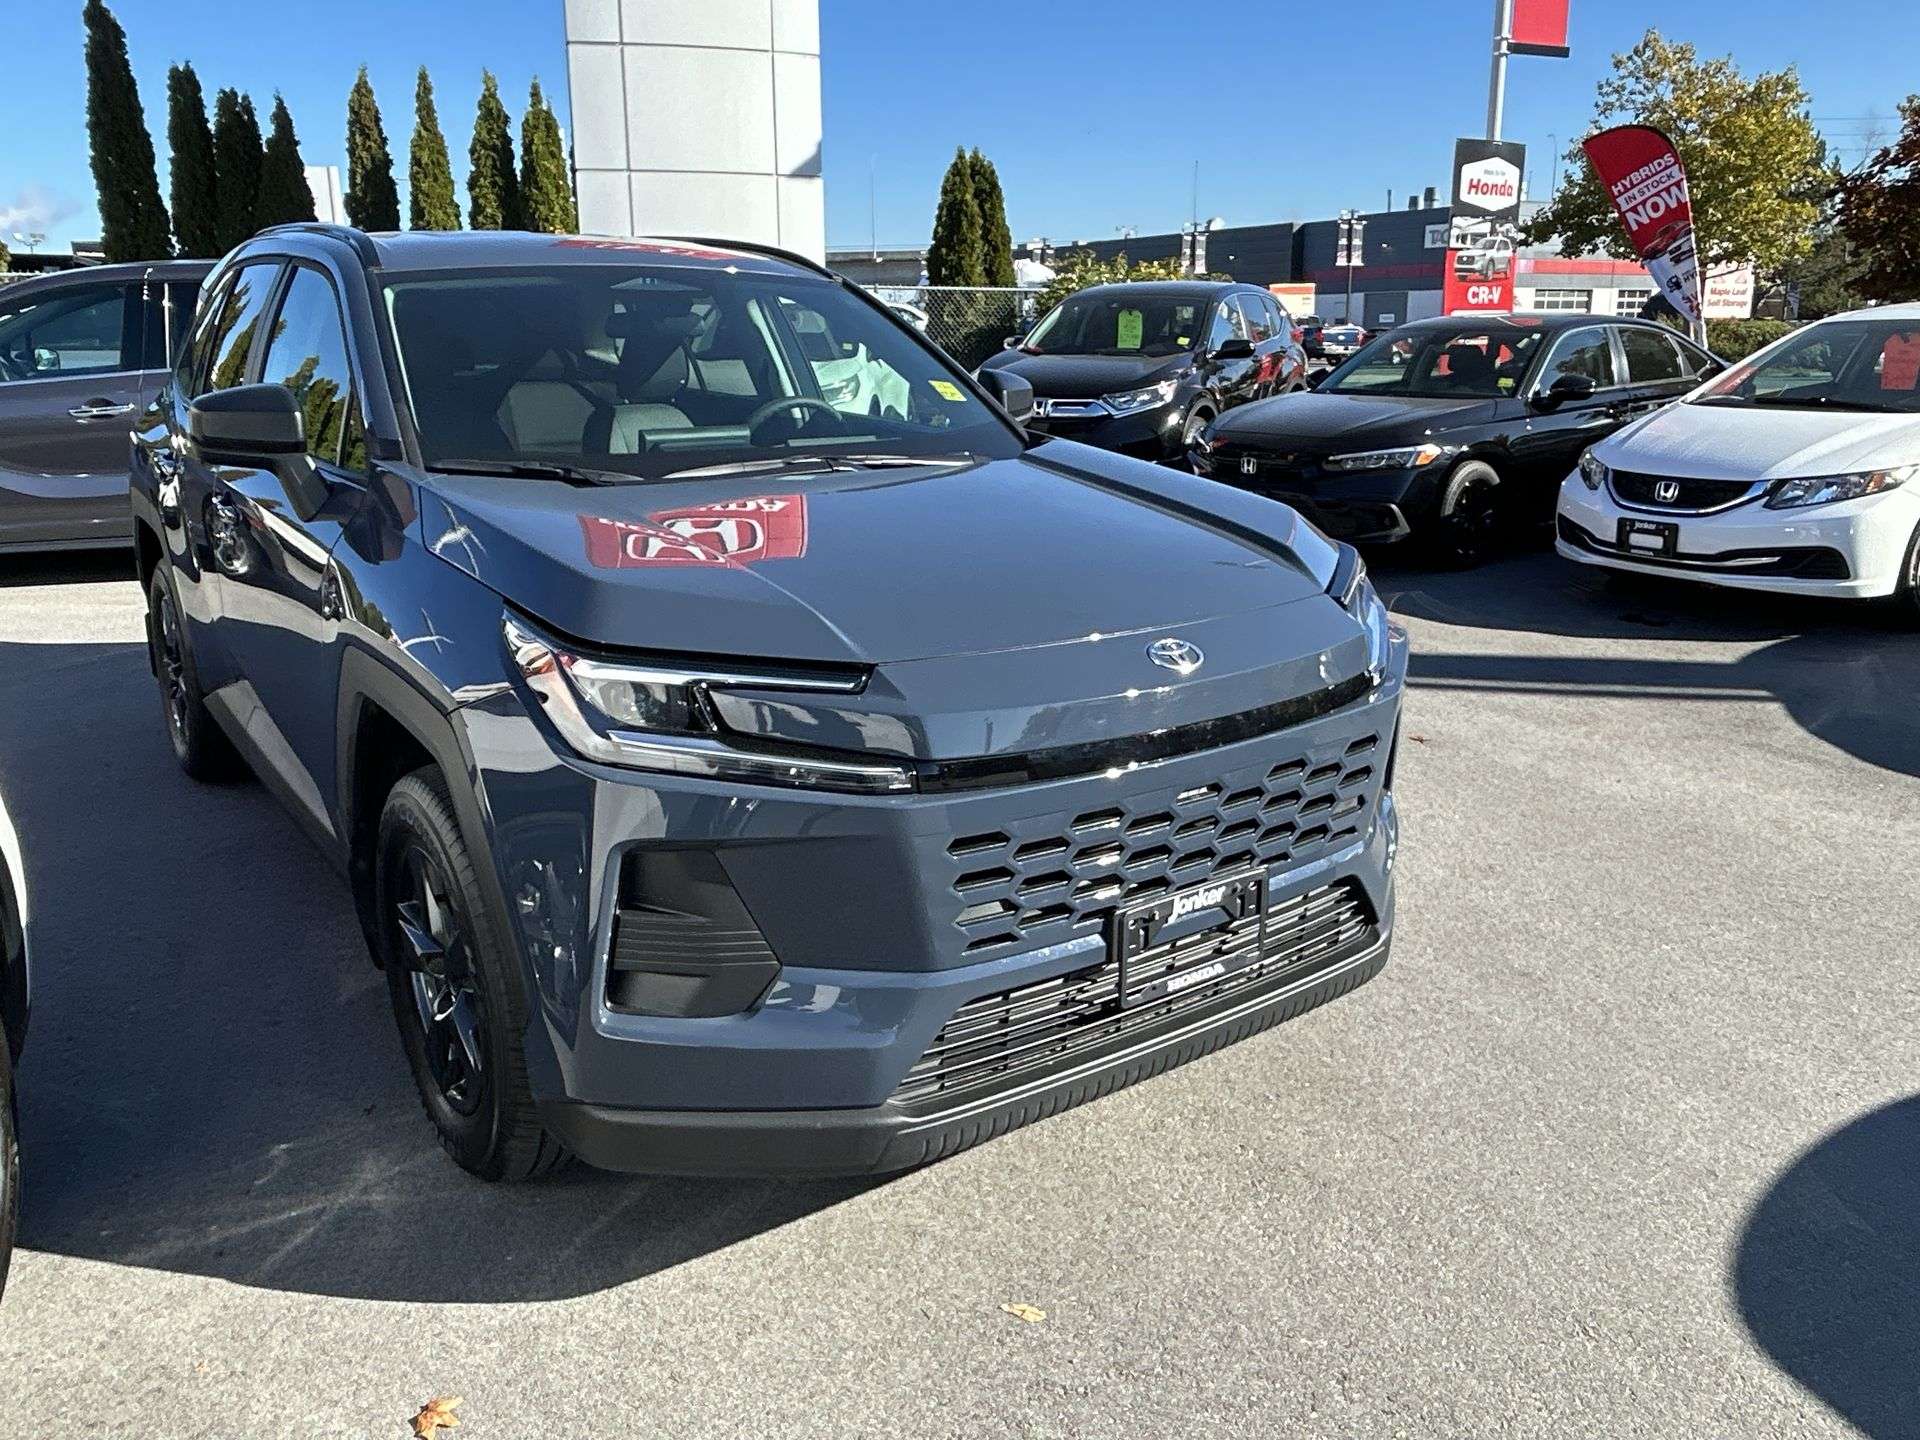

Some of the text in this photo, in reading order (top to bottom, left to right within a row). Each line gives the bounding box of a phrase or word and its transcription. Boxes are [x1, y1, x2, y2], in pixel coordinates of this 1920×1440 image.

[1467, 178, 1514, 197] Honda
[1611, 153, 1675, 196] HYBRIDS
[1623, 171, 1676, 206] IN STOCK
[1625, 181, 1688, 231] NOW
[1467, 286, 1502, 304] CR-V
[1166, 963, 1226, 992] HONDA
